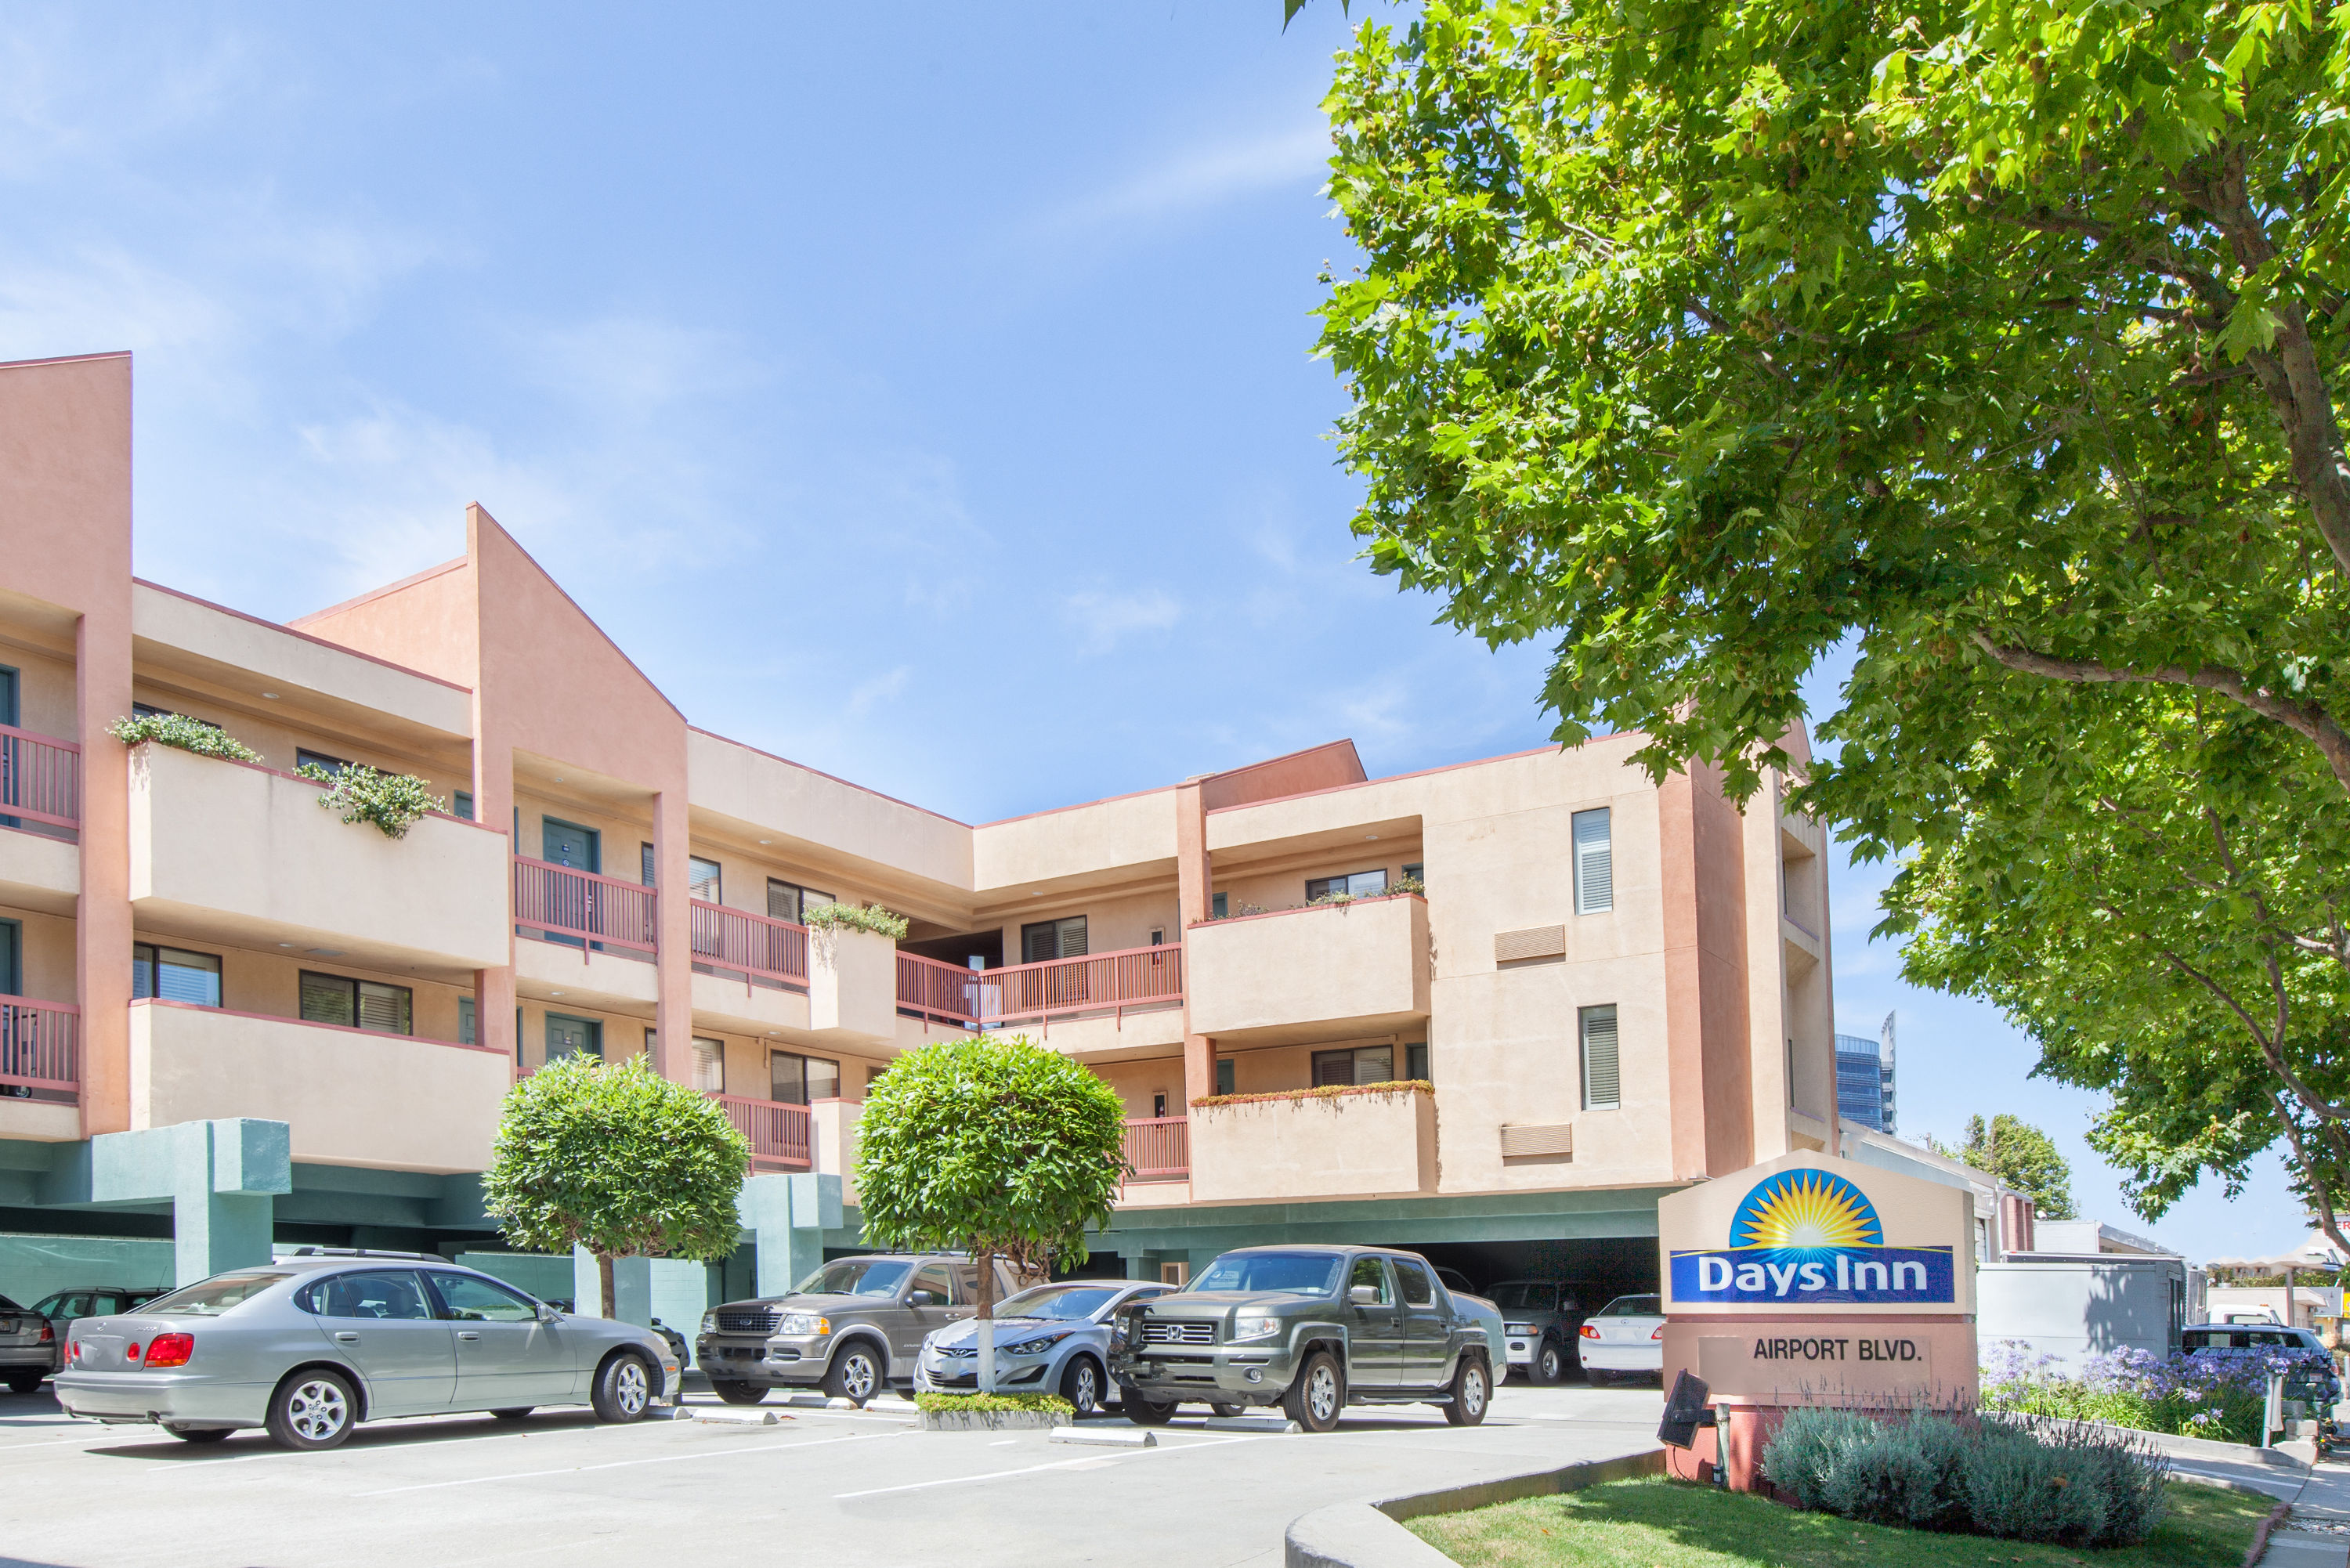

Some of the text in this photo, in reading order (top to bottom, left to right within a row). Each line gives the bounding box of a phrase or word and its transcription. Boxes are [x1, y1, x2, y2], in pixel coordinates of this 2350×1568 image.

[1698, 1255, 1928, 1297] Days Inn
[1753, 1338, 1923, 1362] AIRPORT BLVD.
